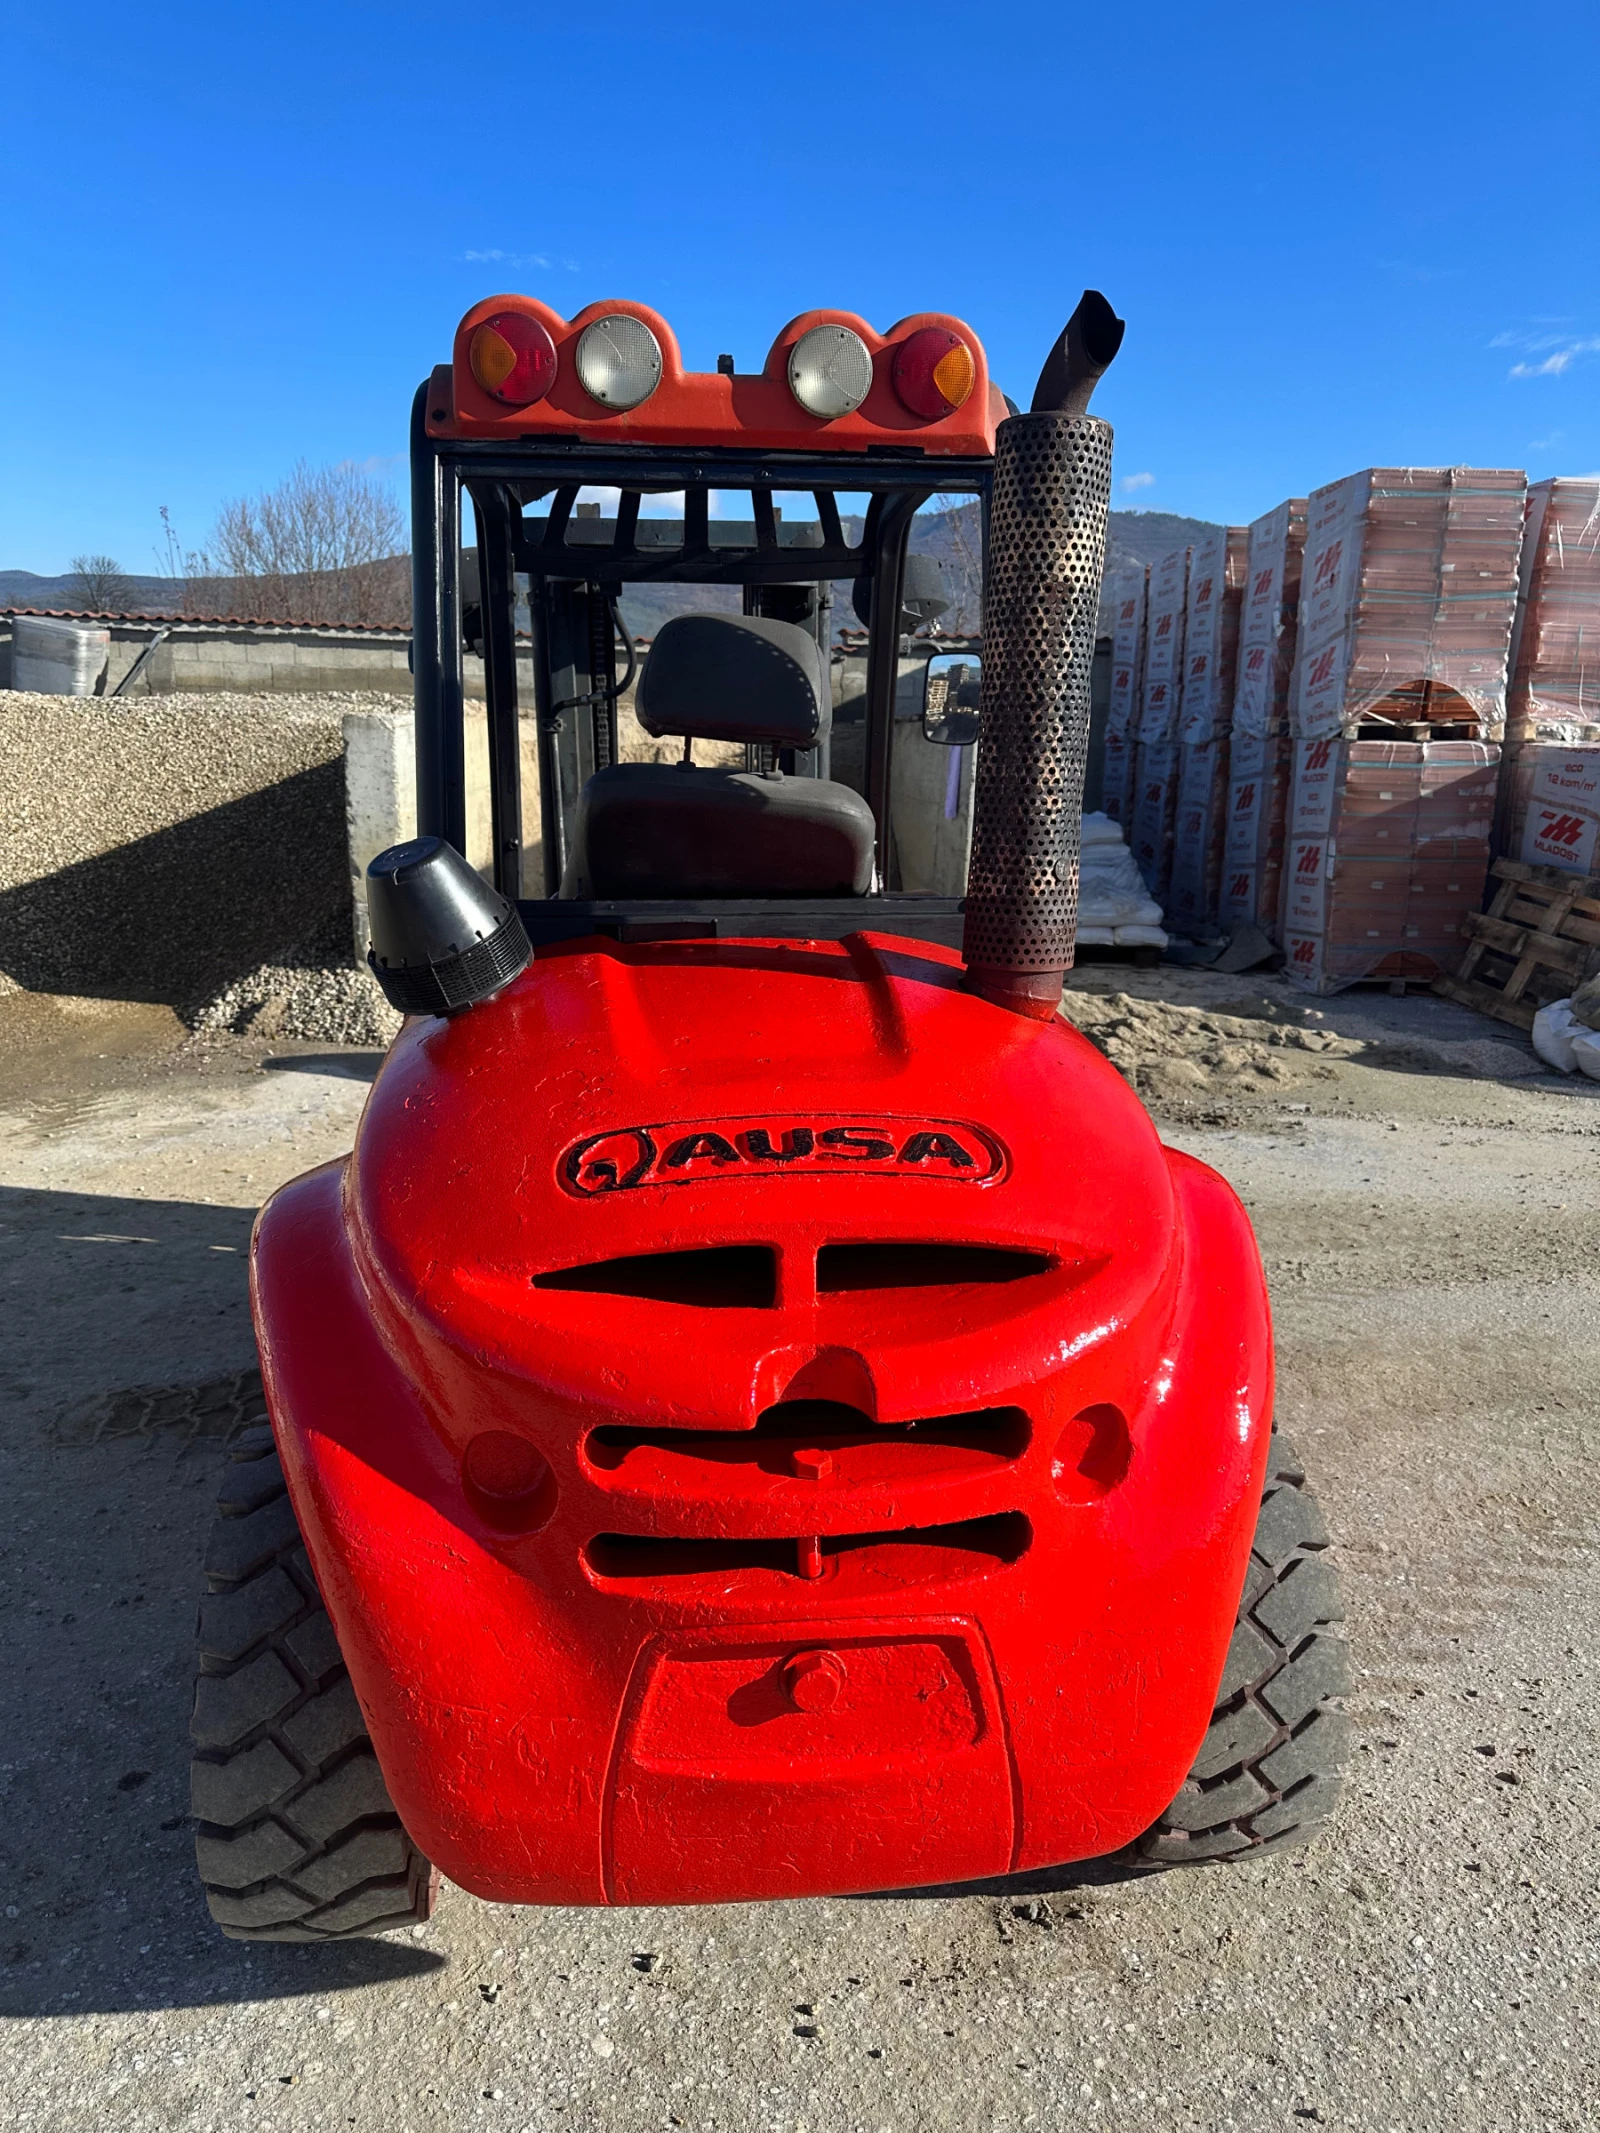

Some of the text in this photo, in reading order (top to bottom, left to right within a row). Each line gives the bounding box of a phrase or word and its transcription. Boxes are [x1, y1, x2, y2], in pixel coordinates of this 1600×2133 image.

[1564, 763, 1584, 773] eco
[1547, 773, 1559, 785] 12
[1534, 839, 1580, 863] MLADOST
[664, 1126, 976, 1168] AUSA
